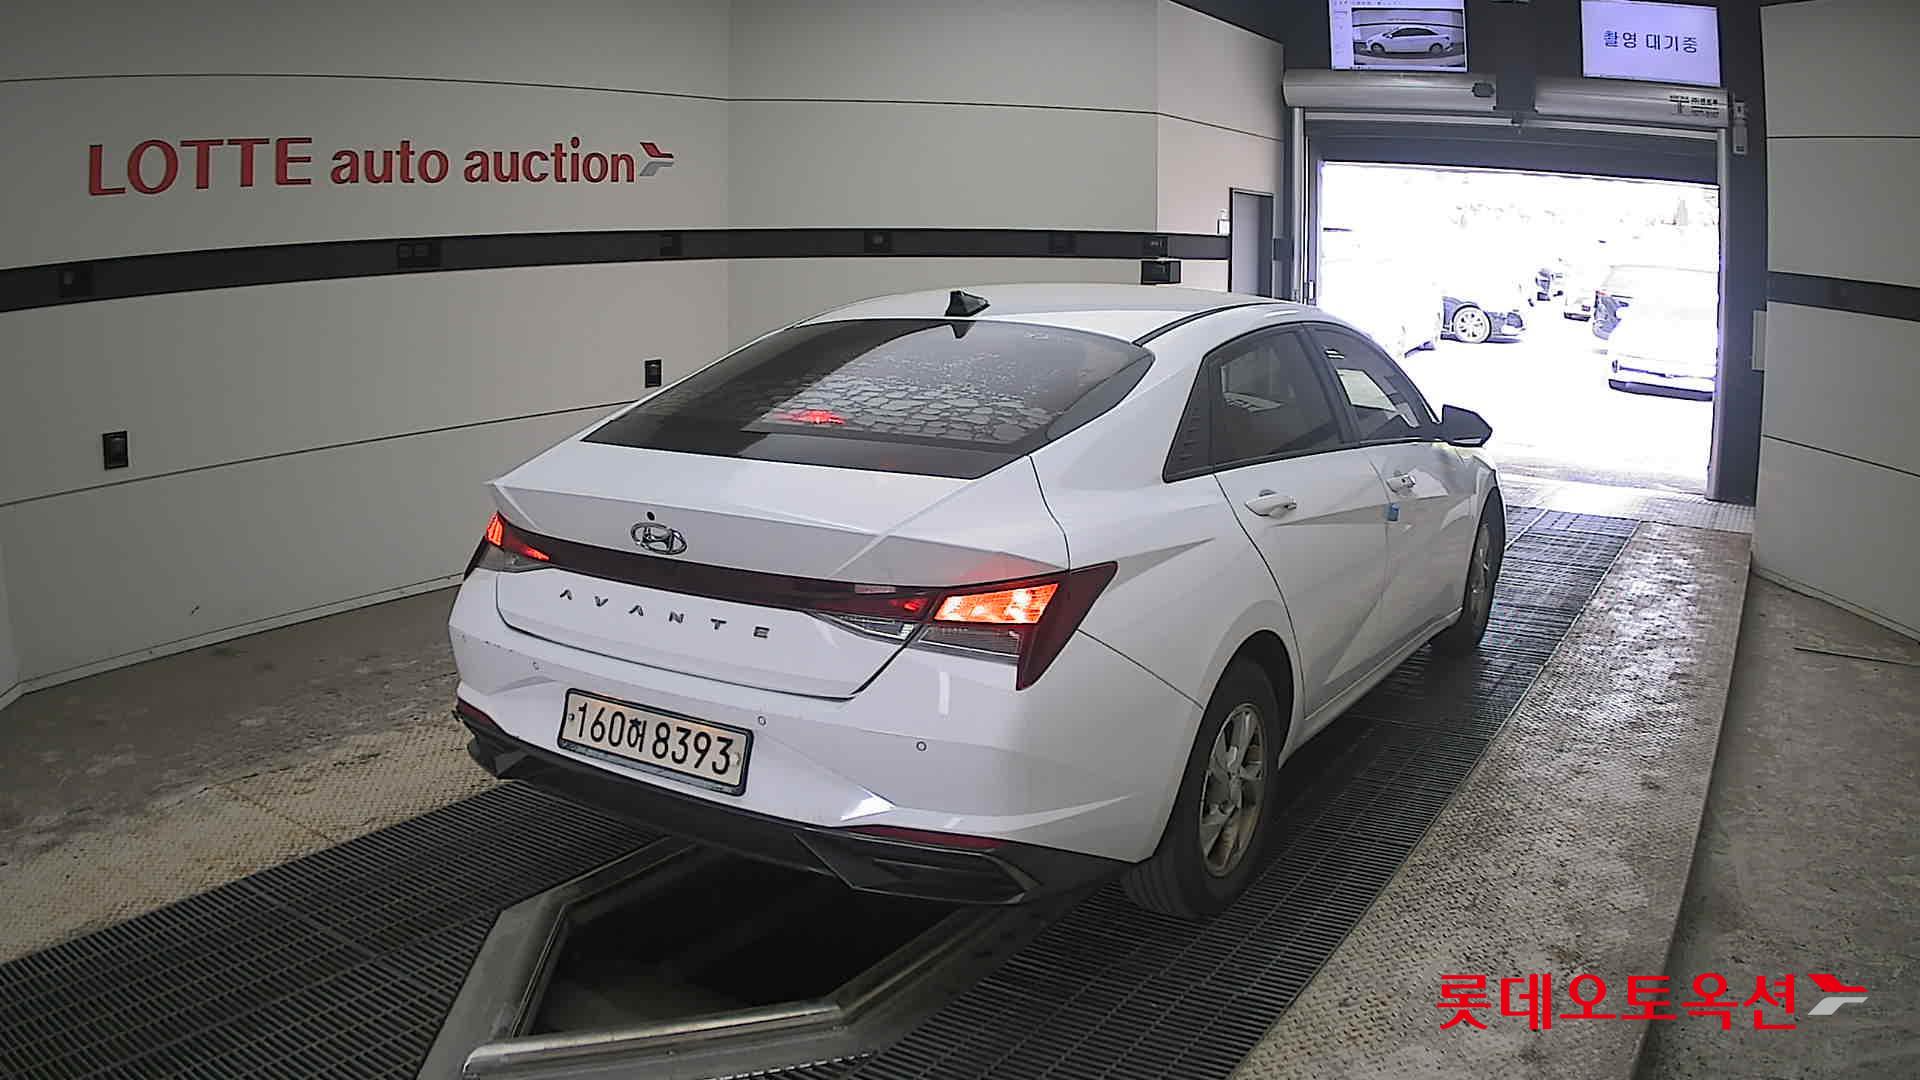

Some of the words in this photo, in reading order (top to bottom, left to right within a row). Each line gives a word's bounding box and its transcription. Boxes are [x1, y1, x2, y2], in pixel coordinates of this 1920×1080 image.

[1645, 33, 1698, 54] 대기중
[88, 136, 313, 197] LOTTE
[330, 140, 449, 186] auto
[463, 136, 636, 184] auction
[559, 588, 771, 640] AVANTE
